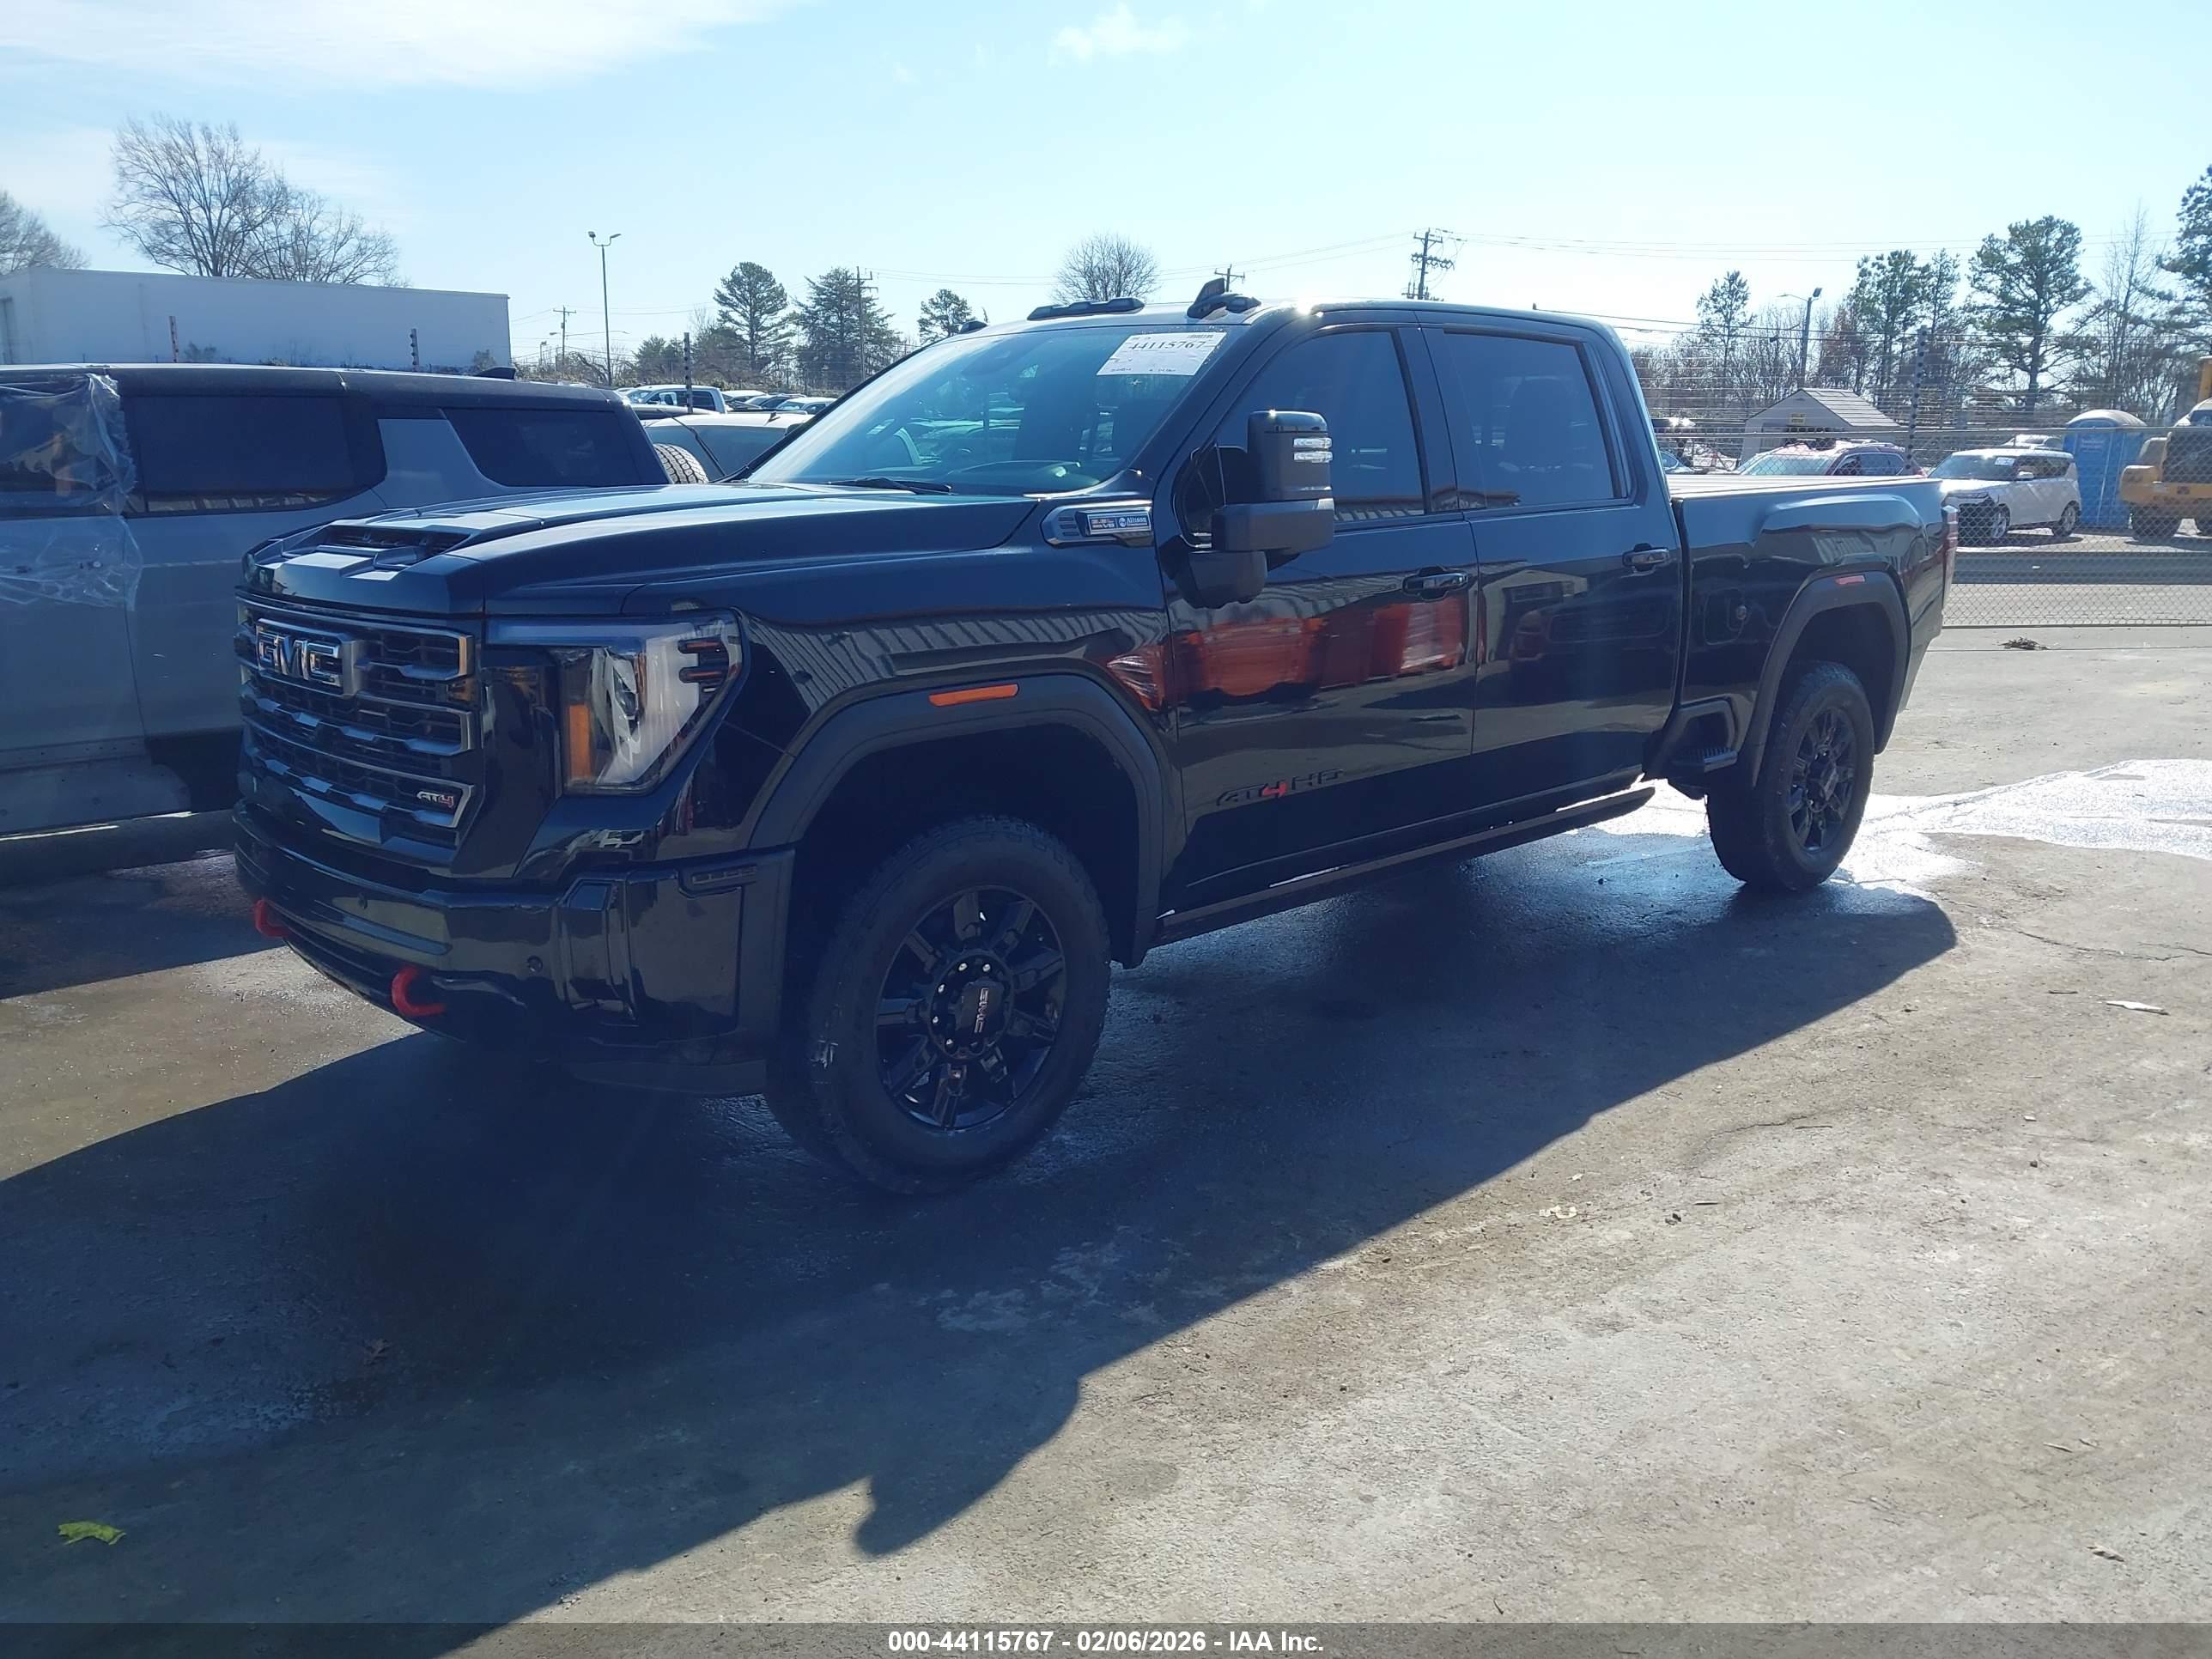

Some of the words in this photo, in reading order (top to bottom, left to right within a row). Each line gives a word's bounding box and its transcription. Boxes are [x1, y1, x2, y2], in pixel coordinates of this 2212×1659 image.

[258, 632, 342, 687] GMC
[416, 791, 454, 808] AT4
[974, 988, 988, 1033] GMC
